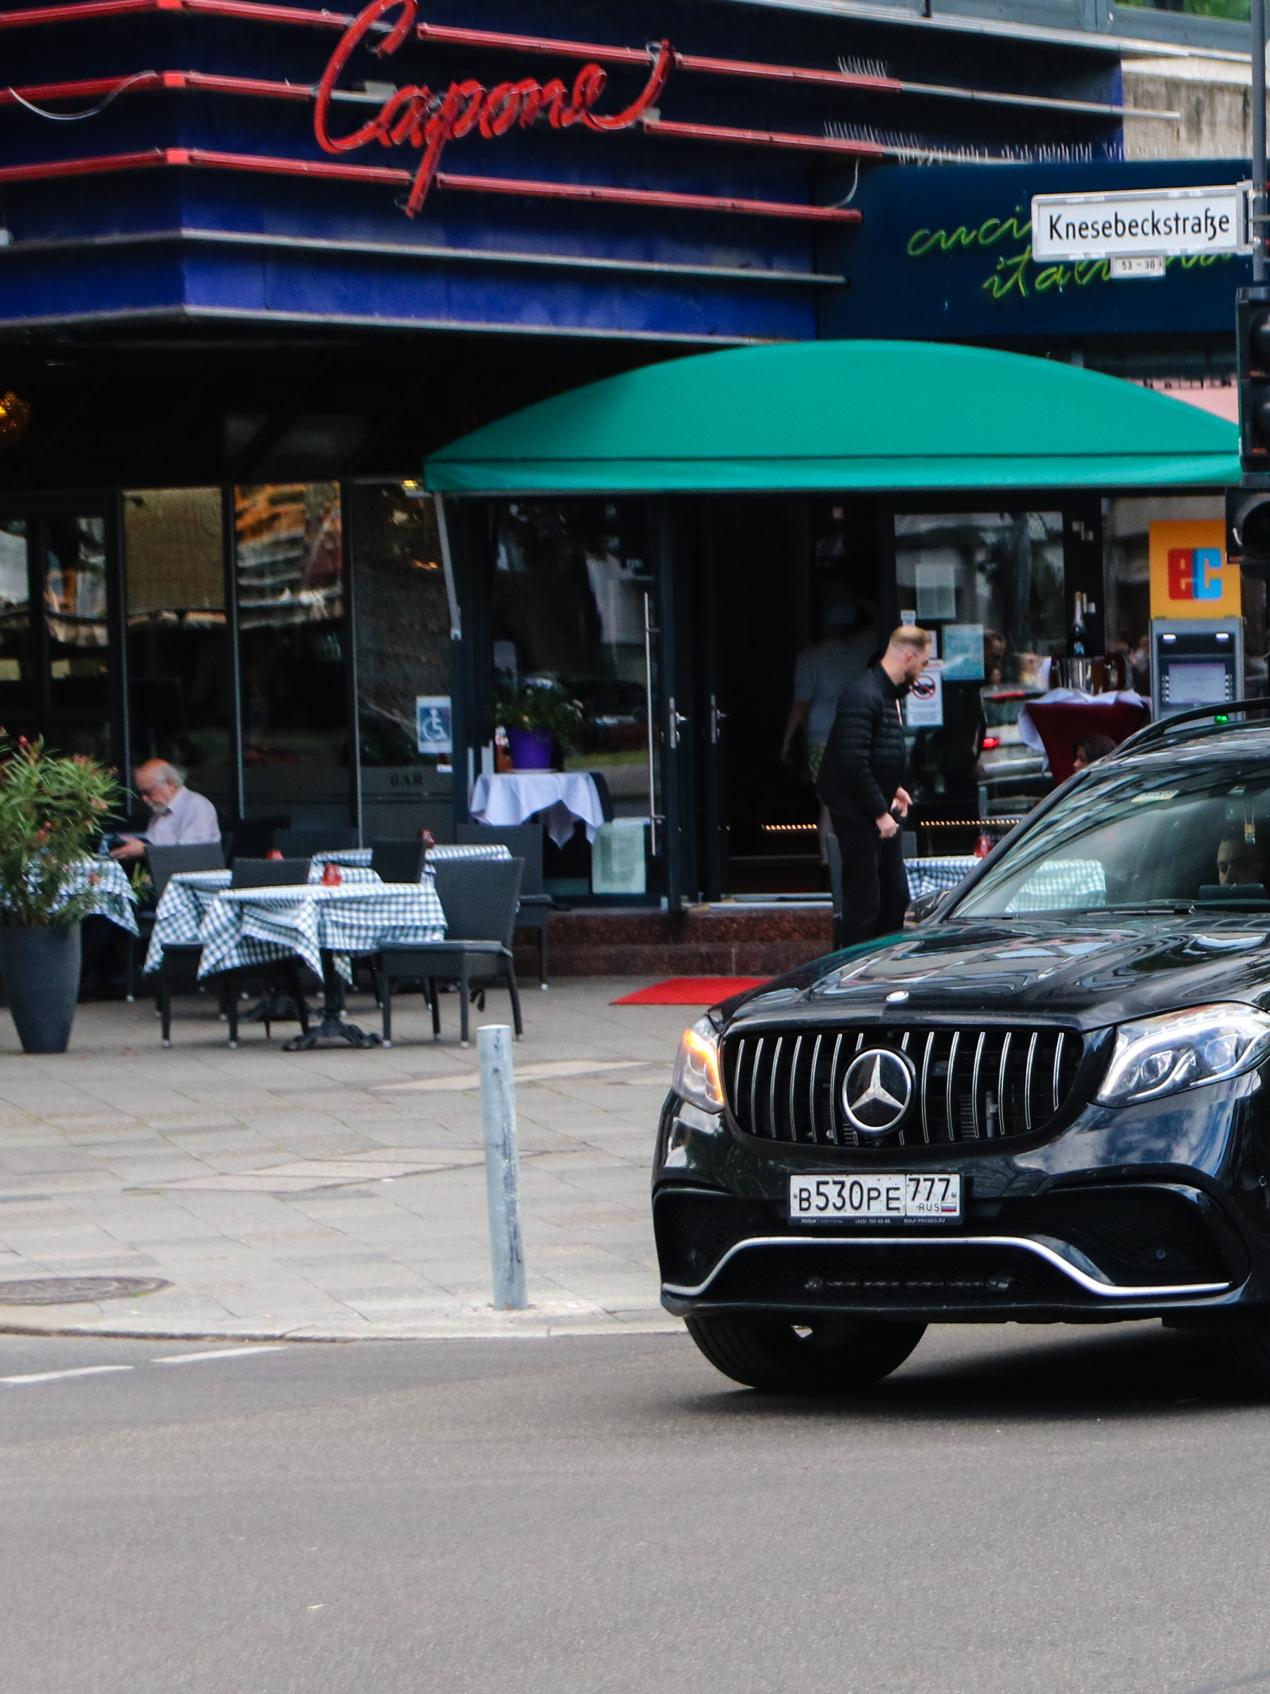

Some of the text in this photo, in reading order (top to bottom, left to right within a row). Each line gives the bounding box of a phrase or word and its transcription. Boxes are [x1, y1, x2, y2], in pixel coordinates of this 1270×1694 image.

[314, 0, 675, 218] Capone
[1049, 207, 1231, 241] Knesebeckstraße
[908, 1177, 951, 1201] 777
[918, 1202, 940, 1212] RUS
